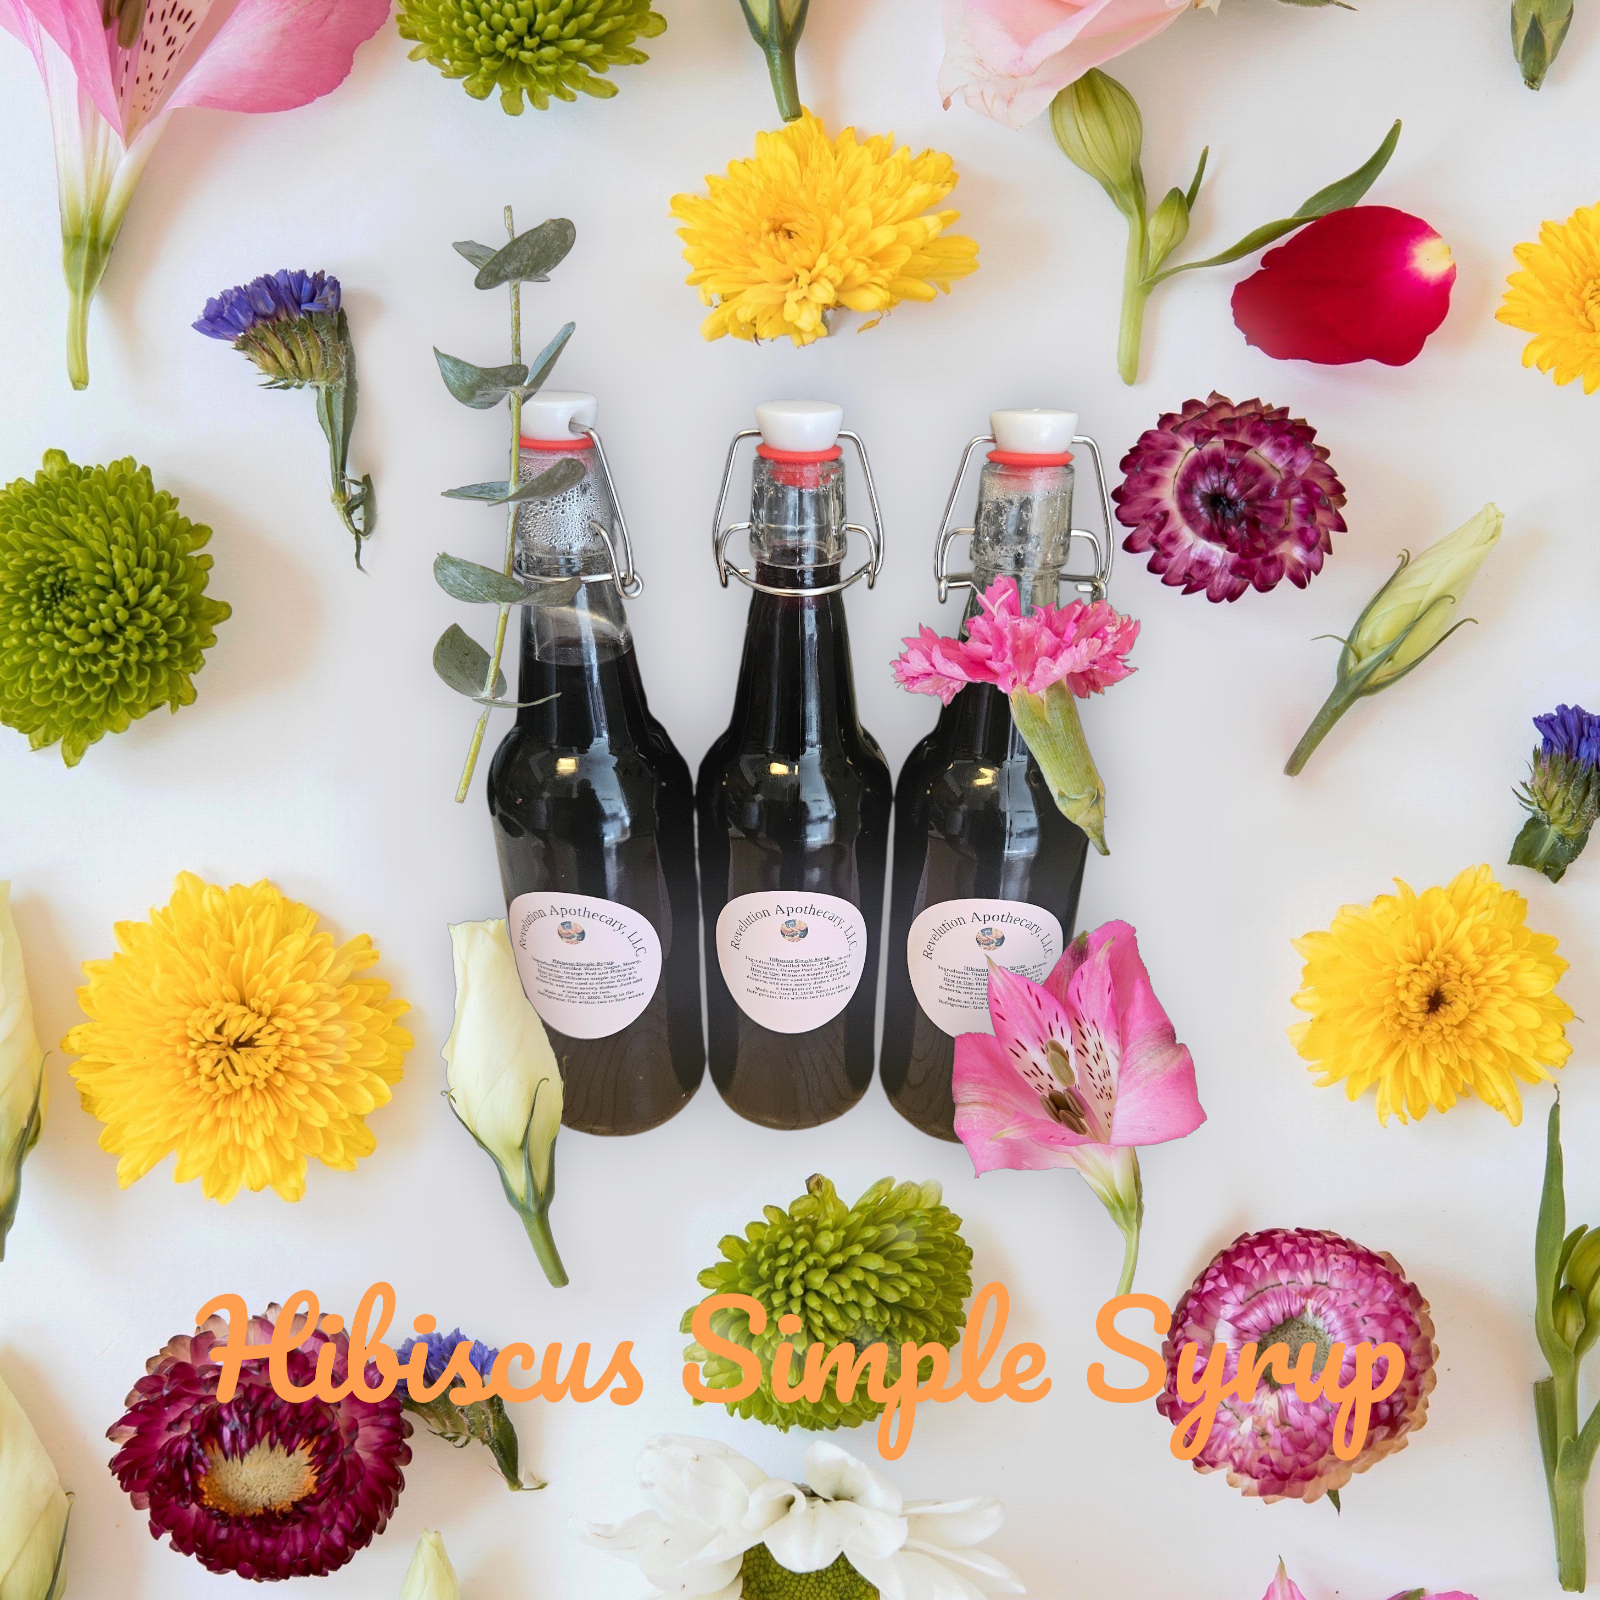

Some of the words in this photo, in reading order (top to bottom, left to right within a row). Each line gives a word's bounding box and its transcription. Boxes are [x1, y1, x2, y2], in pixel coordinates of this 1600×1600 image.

[519, 909, 547, 950] Revelution
[549, 905, 627, 935] Apothecary,
[627, 931, 647, 957] LLC
[730, 908, 771, 951] Revelution
[775, 904, 846, 930] Apothecary,
[844, 925, 858, 950] LLC
[923, 916, 967, 960] Revelution
[970, 912, 1042, 939] Apothecary,
[1040, 933, 1054, 959] LLC
